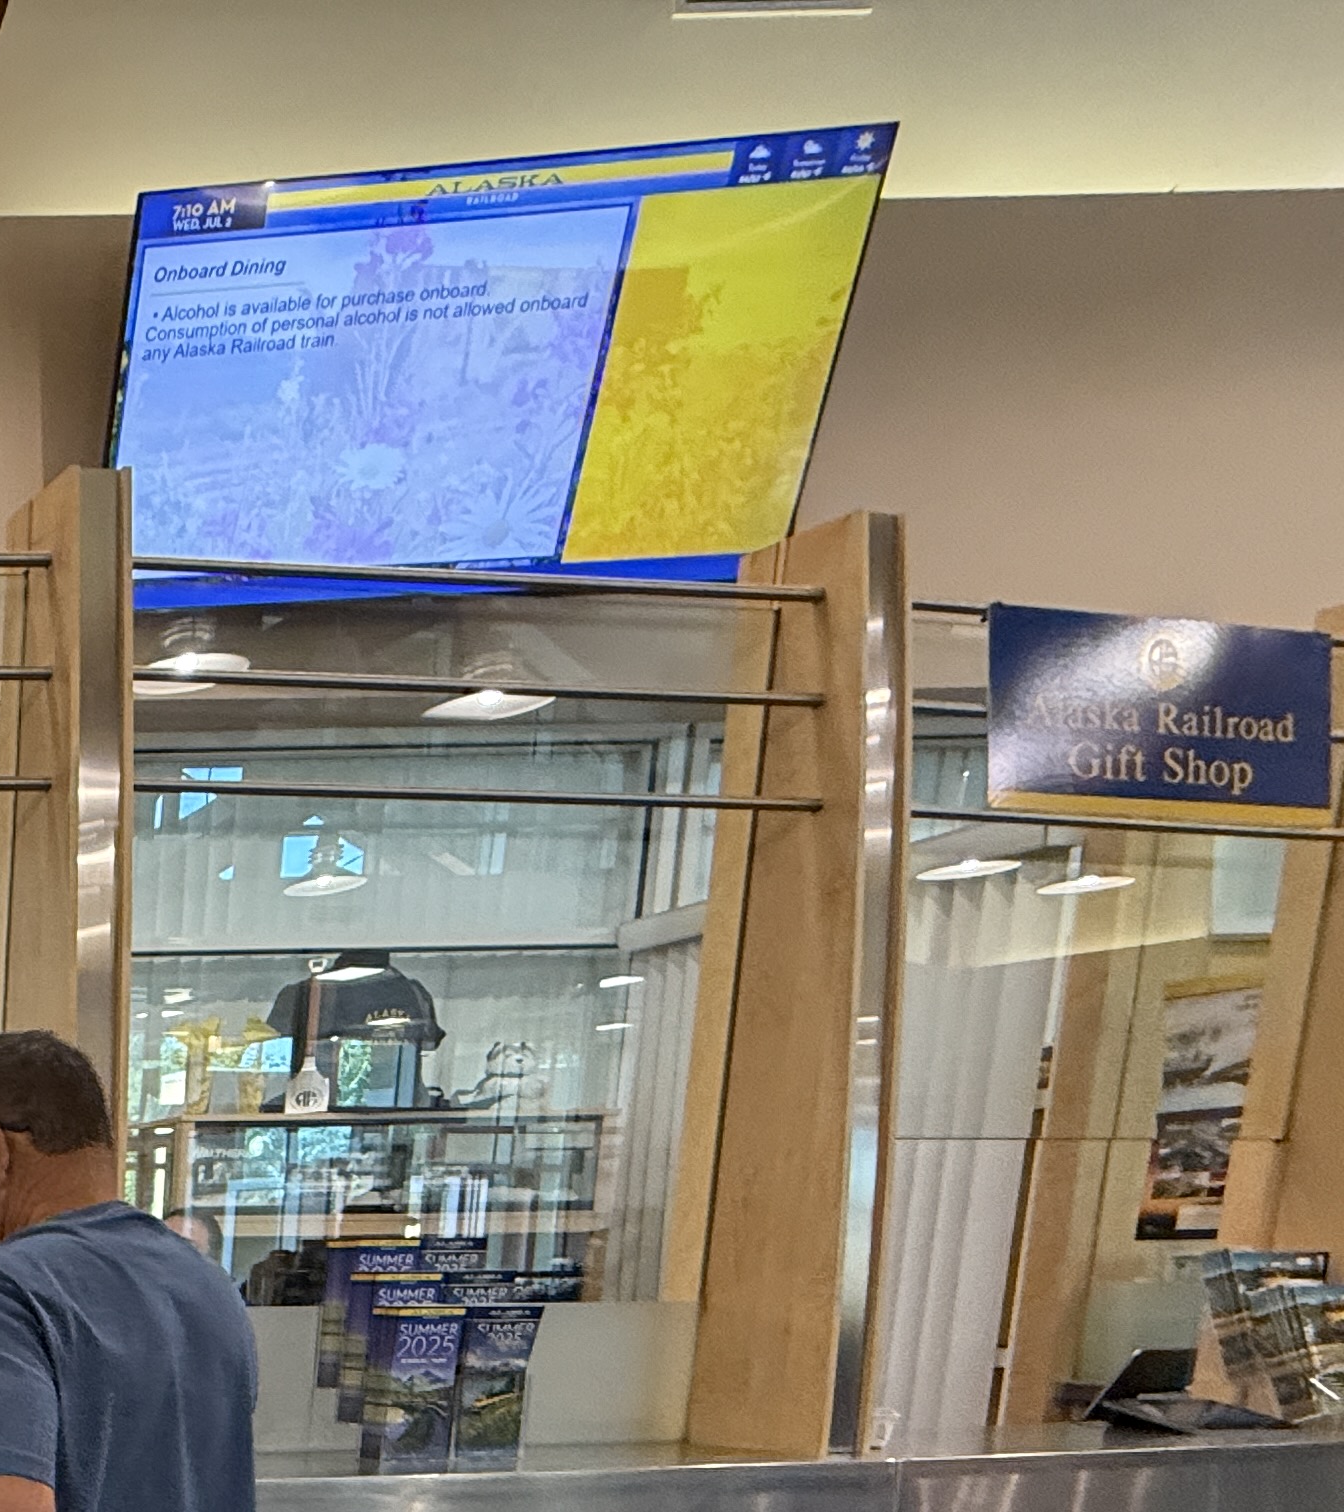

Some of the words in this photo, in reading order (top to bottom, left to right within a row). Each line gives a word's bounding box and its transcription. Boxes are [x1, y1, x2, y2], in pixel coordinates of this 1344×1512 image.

[425, 172, 564, 197] ALASKA
[173, 203, 204, 219] 7:10
[207, 197, 236, 216] AM
[203, 217, 222, 230] JUL
[153, 261, 228, 283] Onboard
[231, 257, 287, 277] Dining
[161, 301, 220, 322] Alcohol
[223, 301, 237, 318] is
[240, 296, 311, 316] available
[315, 292, 338, 310] for
[341, 289, 416, 314] purchase
[419, 280, 491, 302] onboard.
[145, 321, 247, 345] Consumption
[251, 318, 268, 334] of
[271, 312, 340, 336] personal
[343, 307, 401, 327] alcohol
[404, 307, 418, 323] is
[422, 304, 449, 321] not
[452, 298, 515, 319] allowed
[519, 292, 590, 313] onboard
[141, 346, 171, 364] any
[173, 341, 226, 360] Alaska
[230, 336, 296, 355] Railroad
[1026, 693, 1142, 733] Alaska
[1156, 701, 1297, 744] Railroad
[1068, 741, 1148, 783] Gift
[1162, 747, 1255, 796] Shop
[359, 1253, 415, 1266] SUMMER
[377, 1287, 436, 1300] SUMMER
[399, 1323, 459, 1336] SUMMER
[477, 1322, 536, 1333] SUMMER
[397, 1335, 456, 1358] 2025
